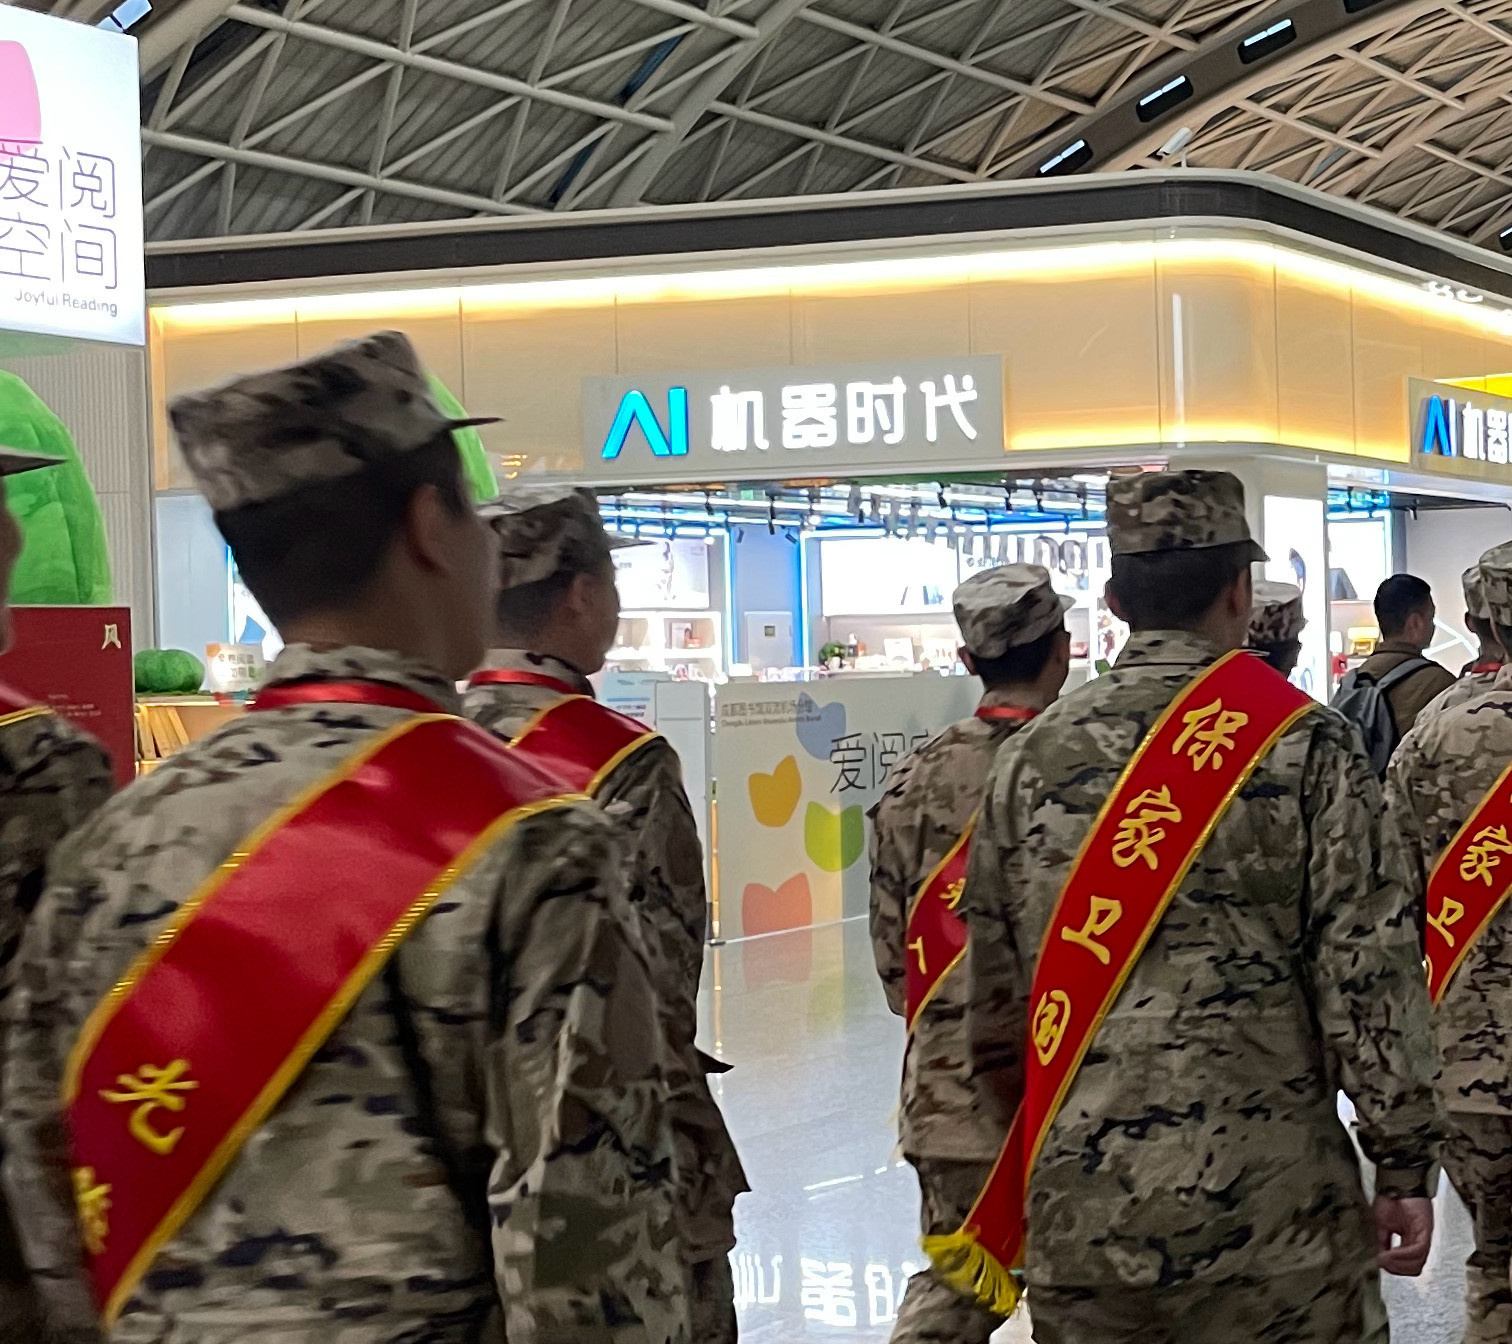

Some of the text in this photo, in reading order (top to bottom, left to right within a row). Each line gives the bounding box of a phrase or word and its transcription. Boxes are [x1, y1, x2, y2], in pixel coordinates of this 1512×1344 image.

[0, 212, 117, 290] 空间
[62, 293, 117, 317] Reading
[602, 375, 978, 459] AI 机器时代
[1423, 394, 1457, 457] AI
[829, 729, 929, 794] 爱阅
[1031, 697, 1250, 1066] 保家卫国
